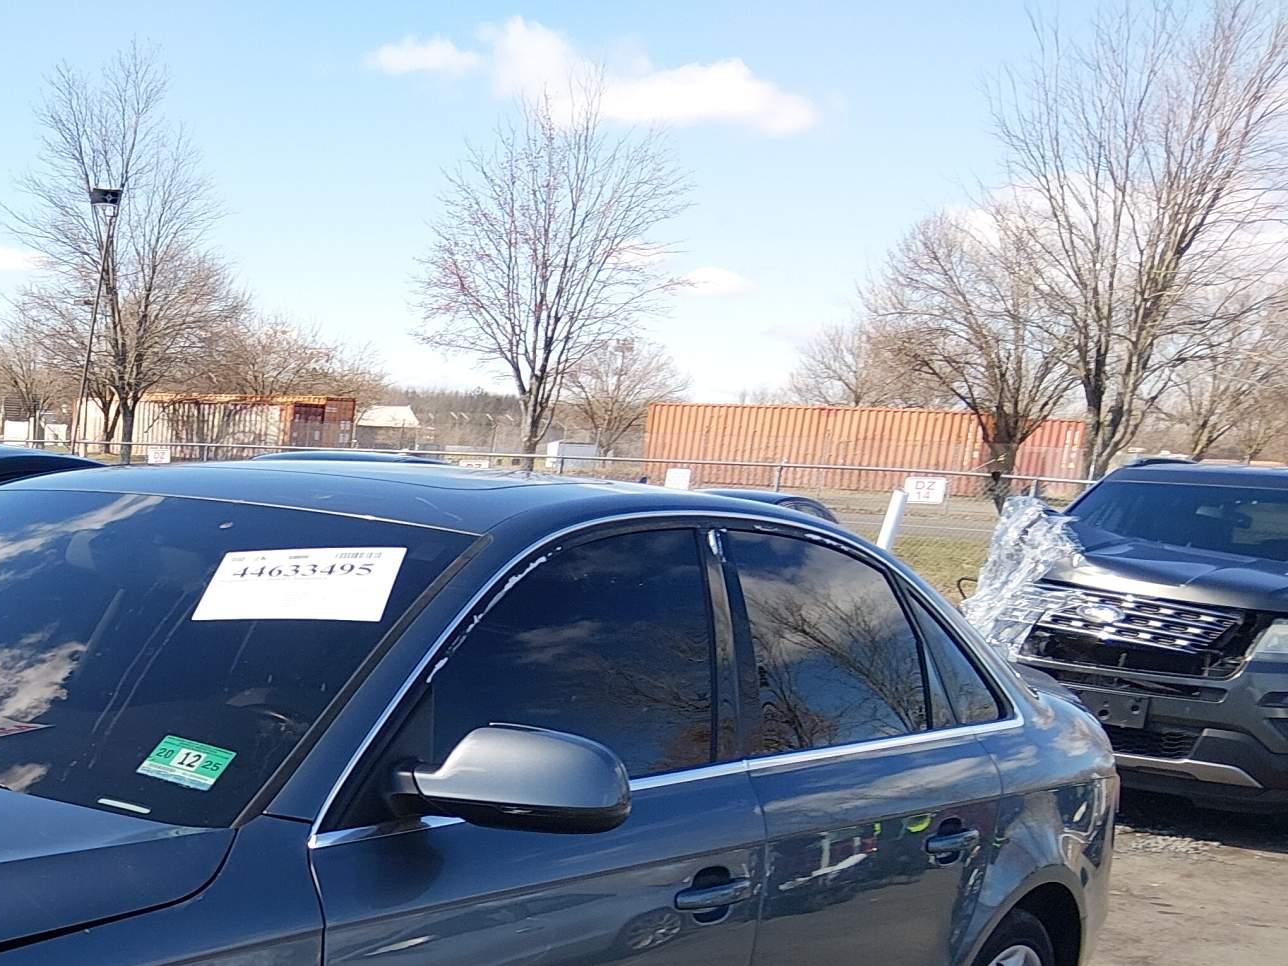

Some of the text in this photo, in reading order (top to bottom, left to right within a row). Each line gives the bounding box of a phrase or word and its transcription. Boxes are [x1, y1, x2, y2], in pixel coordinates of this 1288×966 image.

[915, 480, 937, 490] DZ
[232, 562, 375, 578] 44633495
[156, 747, 175, 759] 20
[177, 751, 202, 769] 12
[201, 760, 223, 772] 25
